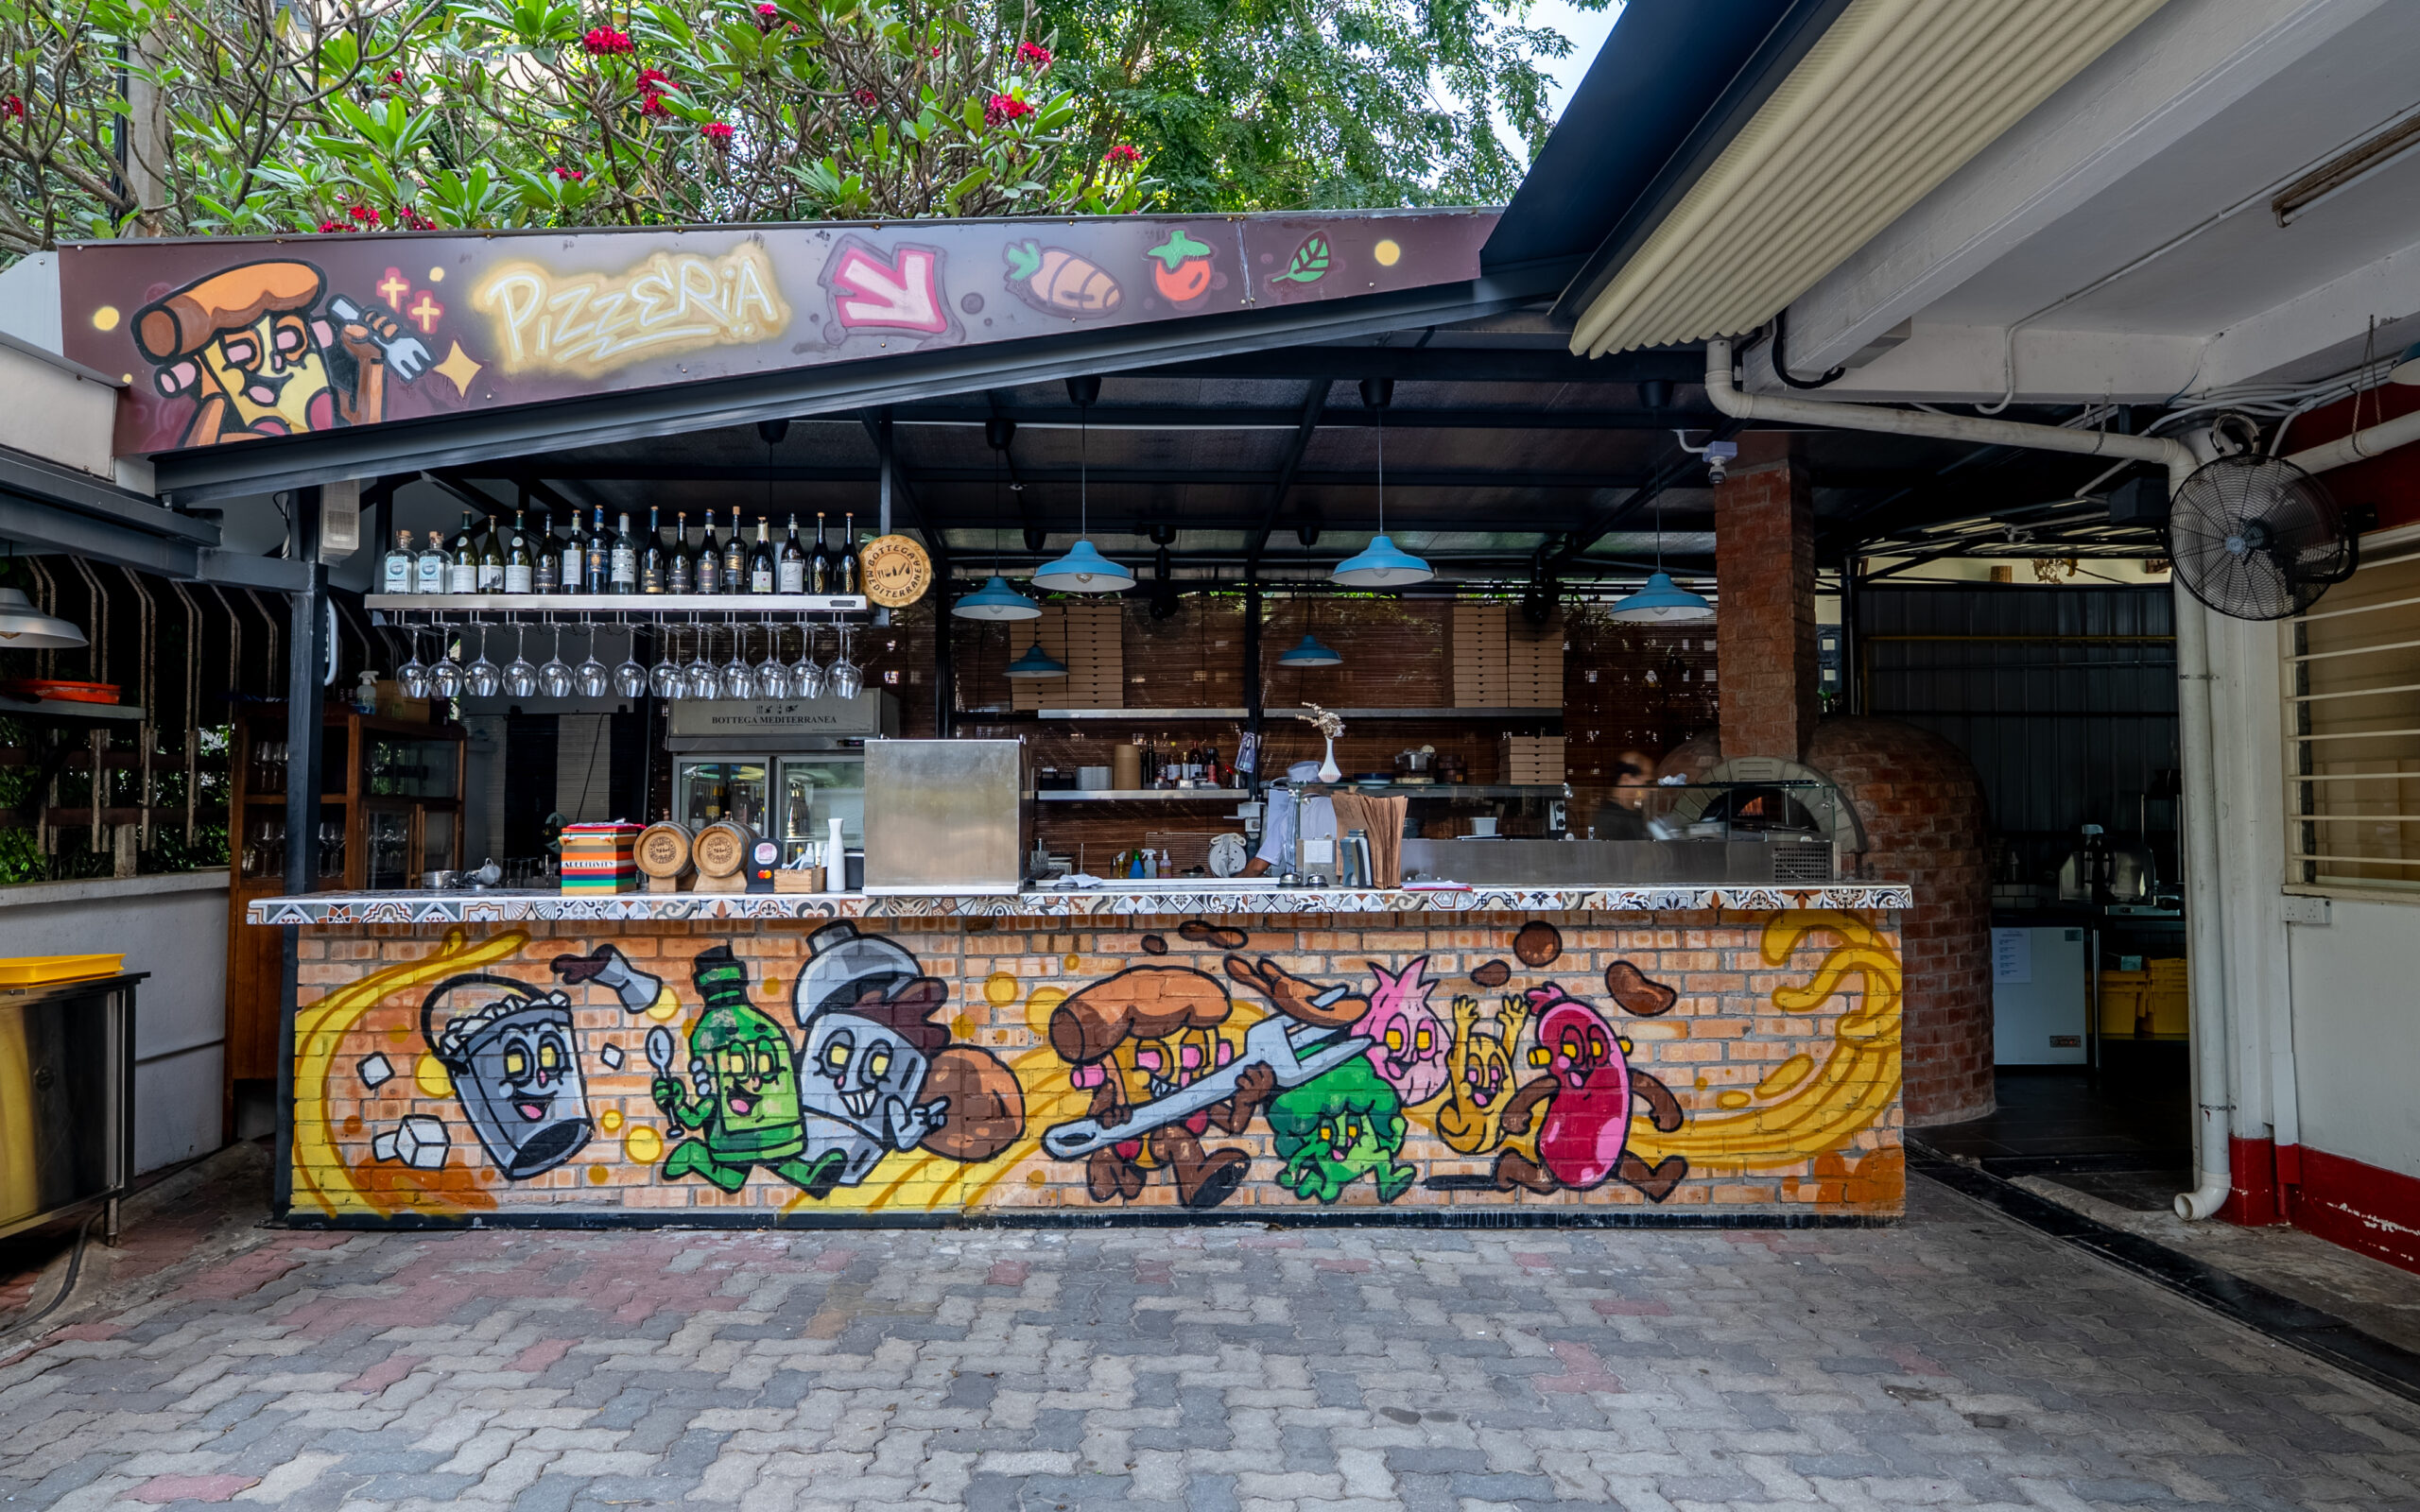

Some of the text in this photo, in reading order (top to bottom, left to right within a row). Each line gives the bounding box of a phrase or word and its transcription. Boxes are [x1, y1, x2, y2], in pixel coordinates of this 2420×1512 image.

[865, 544, 922, 597] BOTTEGA MEDITERRANEA
[712, 715, 837, 725] BOTTEGA MEDITERRANEA
